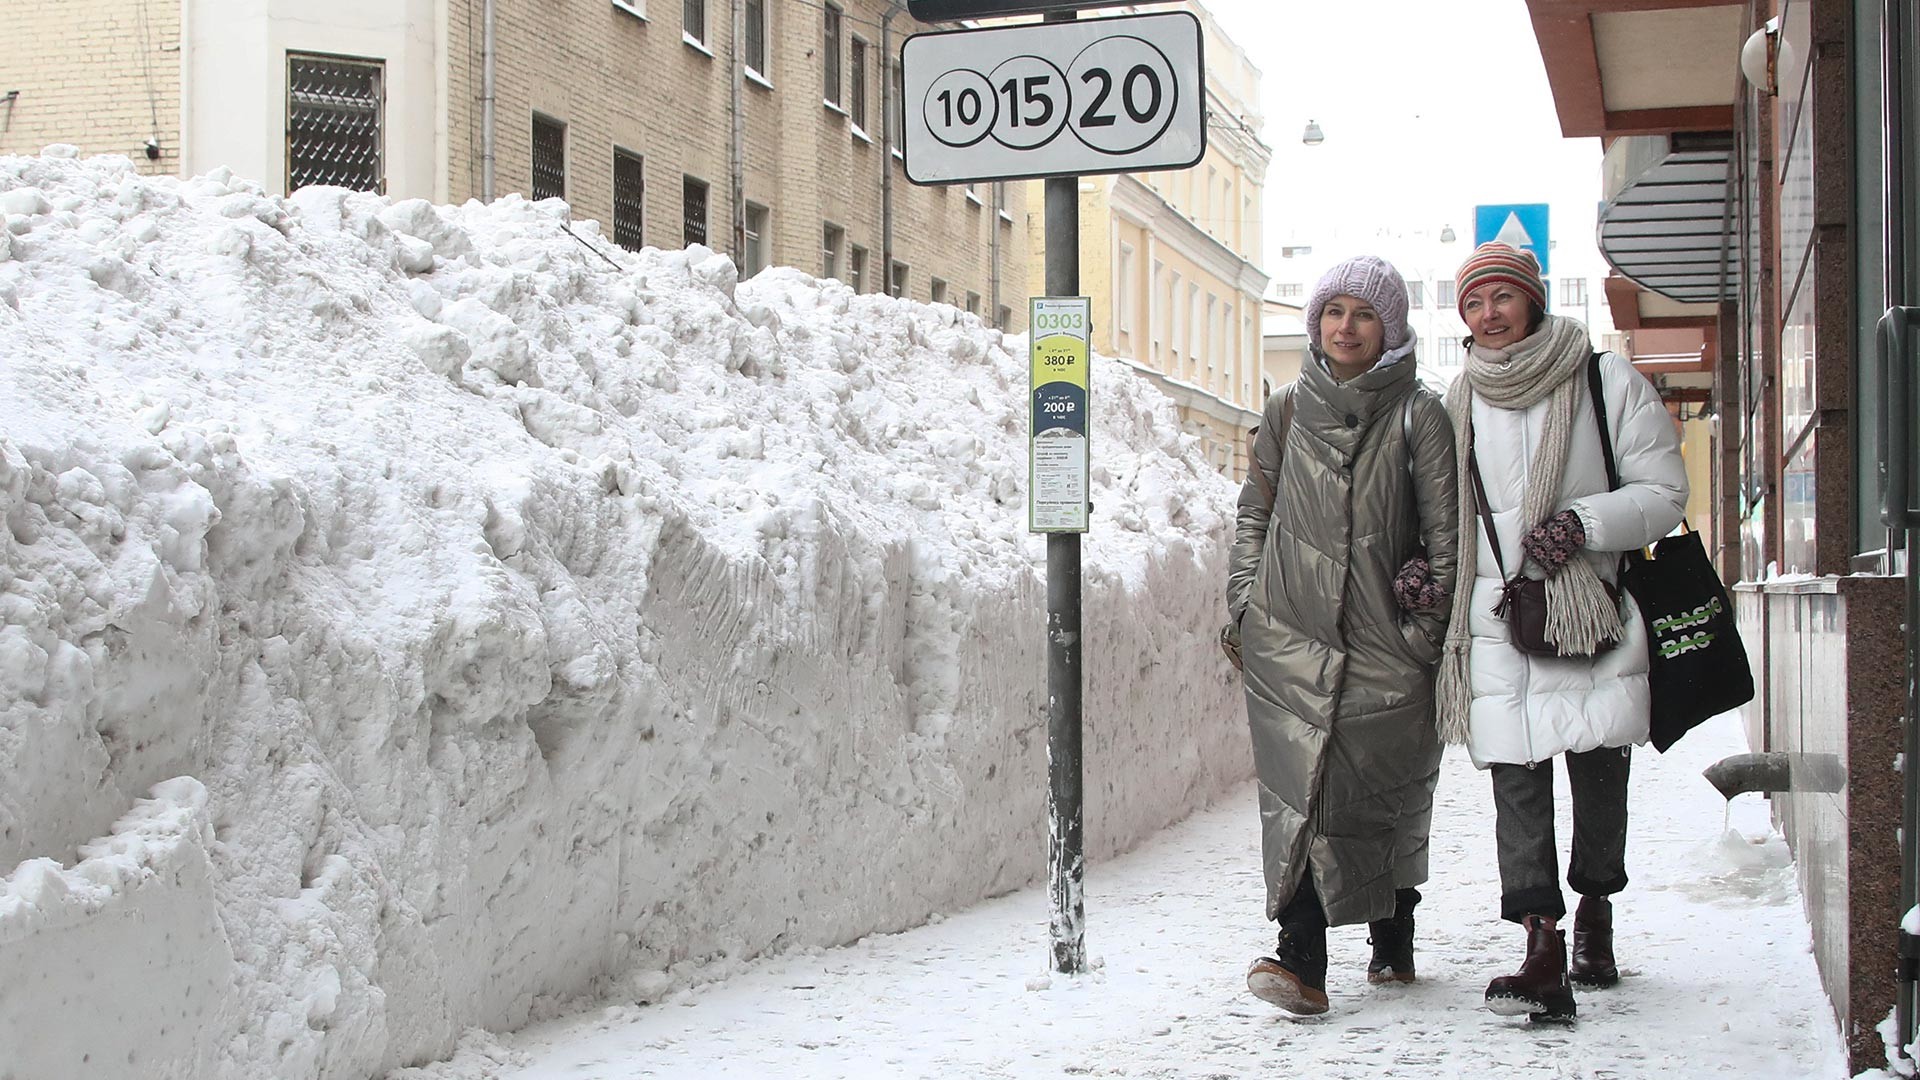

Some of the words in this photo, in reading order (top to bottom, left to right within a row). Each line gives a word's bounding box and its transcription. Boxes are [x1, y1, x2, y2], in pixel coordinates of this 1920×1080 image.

[936, 88, 982, 127] 10
[1000, 75, 1053, 128] 15
[1079, 64, 1162, 128] 20
[1037, 313, 1082, 329] 0303
